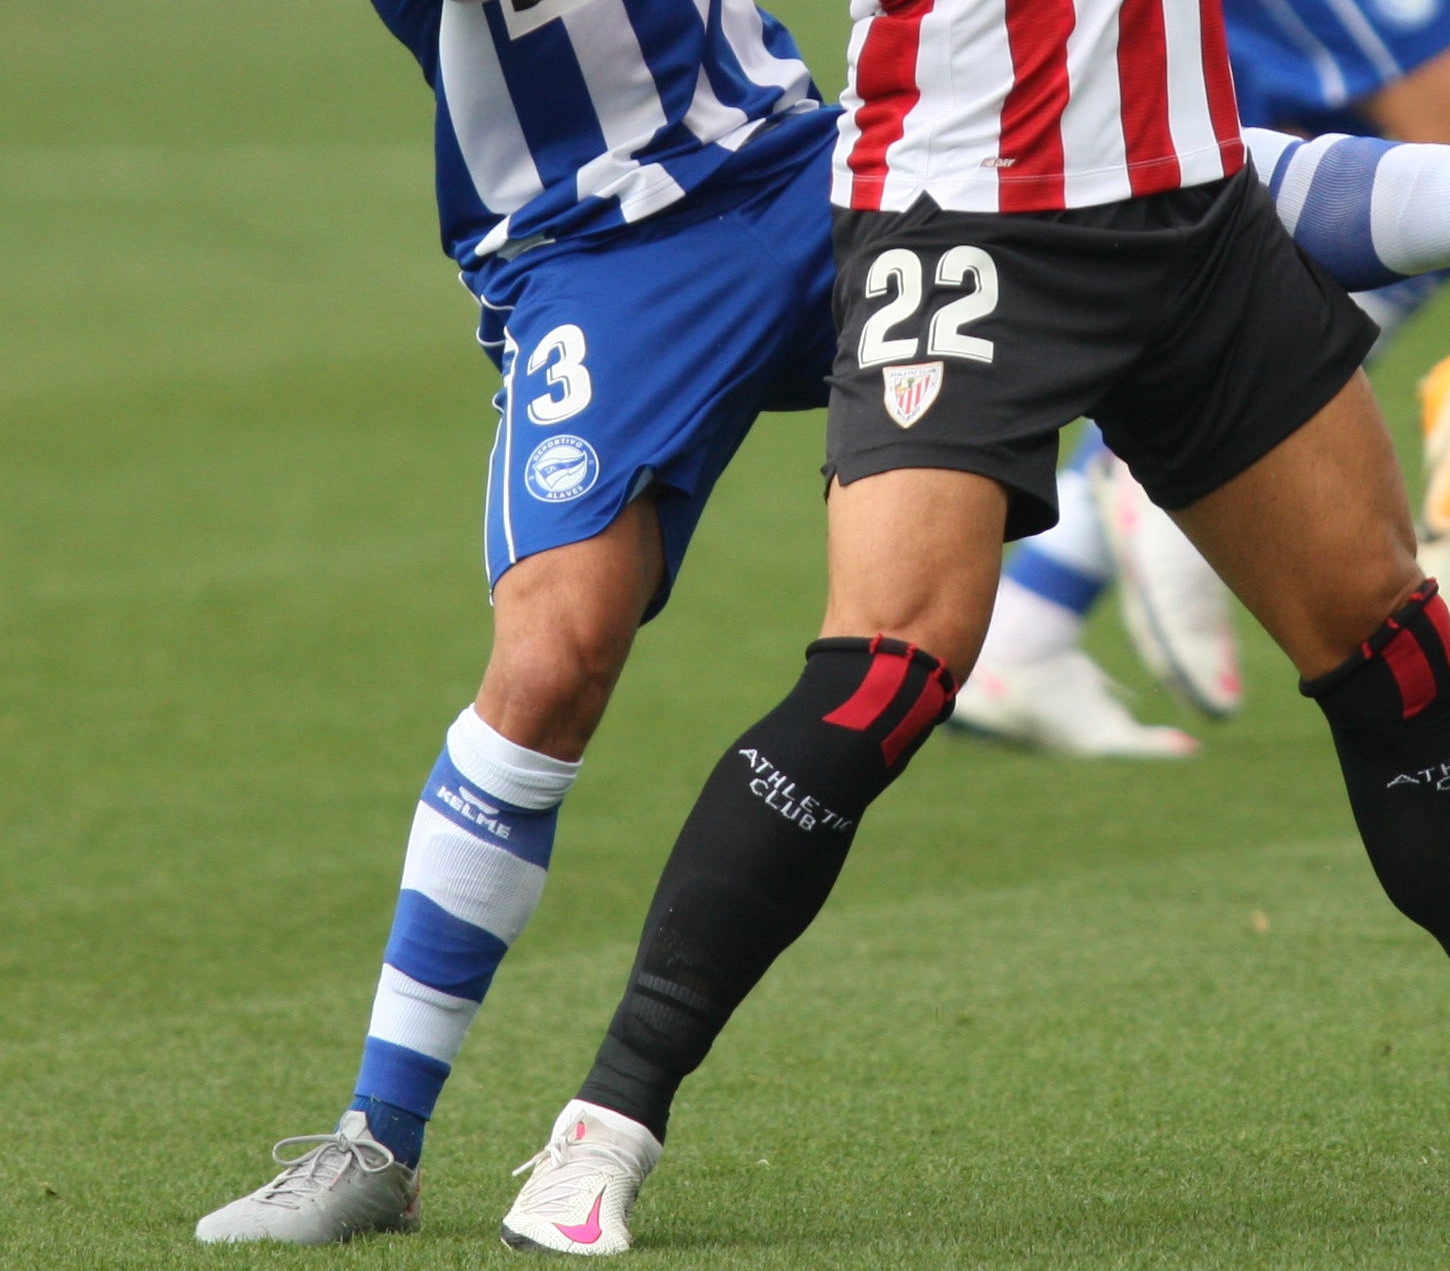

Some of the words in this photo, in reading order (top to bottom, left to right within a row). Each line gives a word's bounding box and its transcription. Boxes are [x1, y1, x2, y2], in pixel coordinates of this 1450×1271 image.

[857, 245, 999, 369] 22
[526, 323, 592, 426] 3
[533, 437, 583, 461] DEPORTIVO
[436, 785, 512, 840] KELME
[749, 777, 817, 832] CLUB
